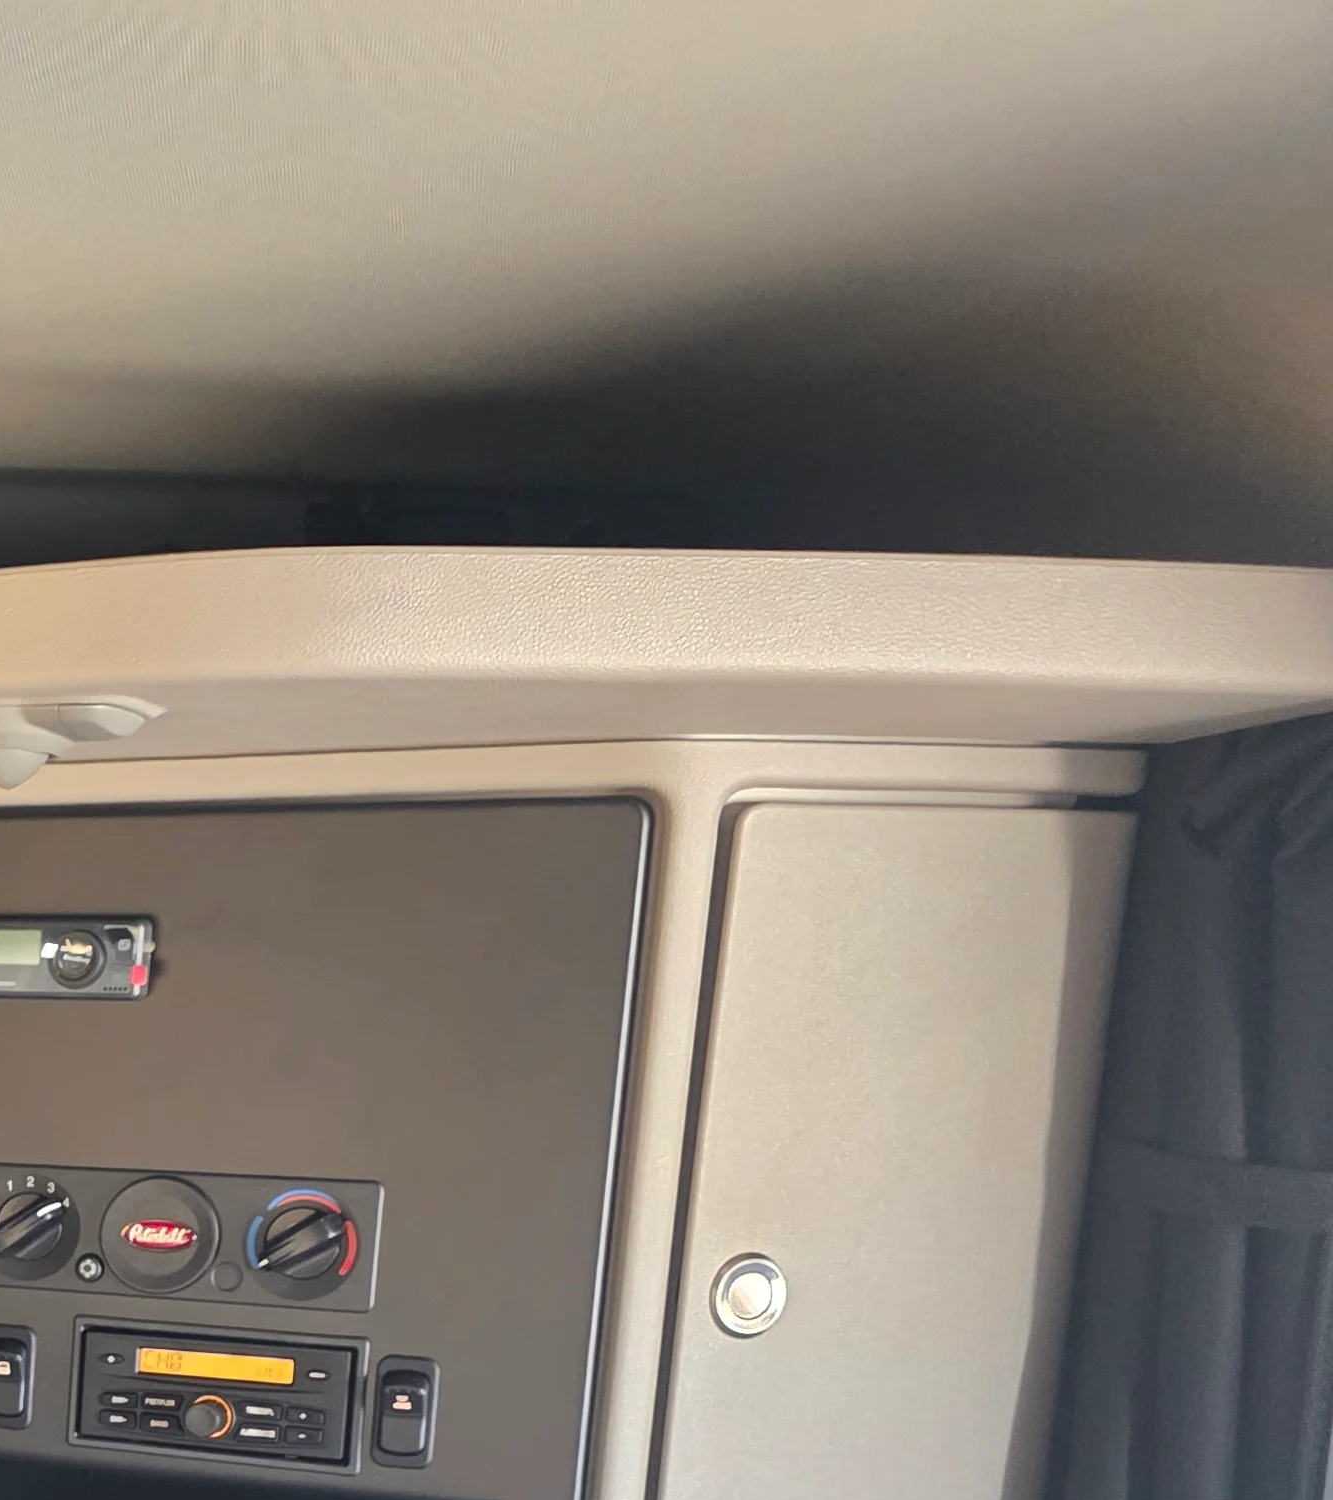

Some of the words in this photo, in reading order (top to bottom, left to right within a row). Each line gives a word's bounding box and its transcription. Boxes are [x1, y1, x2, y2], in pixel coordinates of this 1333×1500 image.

[6, 1179, 13, 1192] 1
[26, 1175, 35, 1188] 2
[46, 1181, 56, 1194] 3
[62, 1196, 70, 1208] 4
